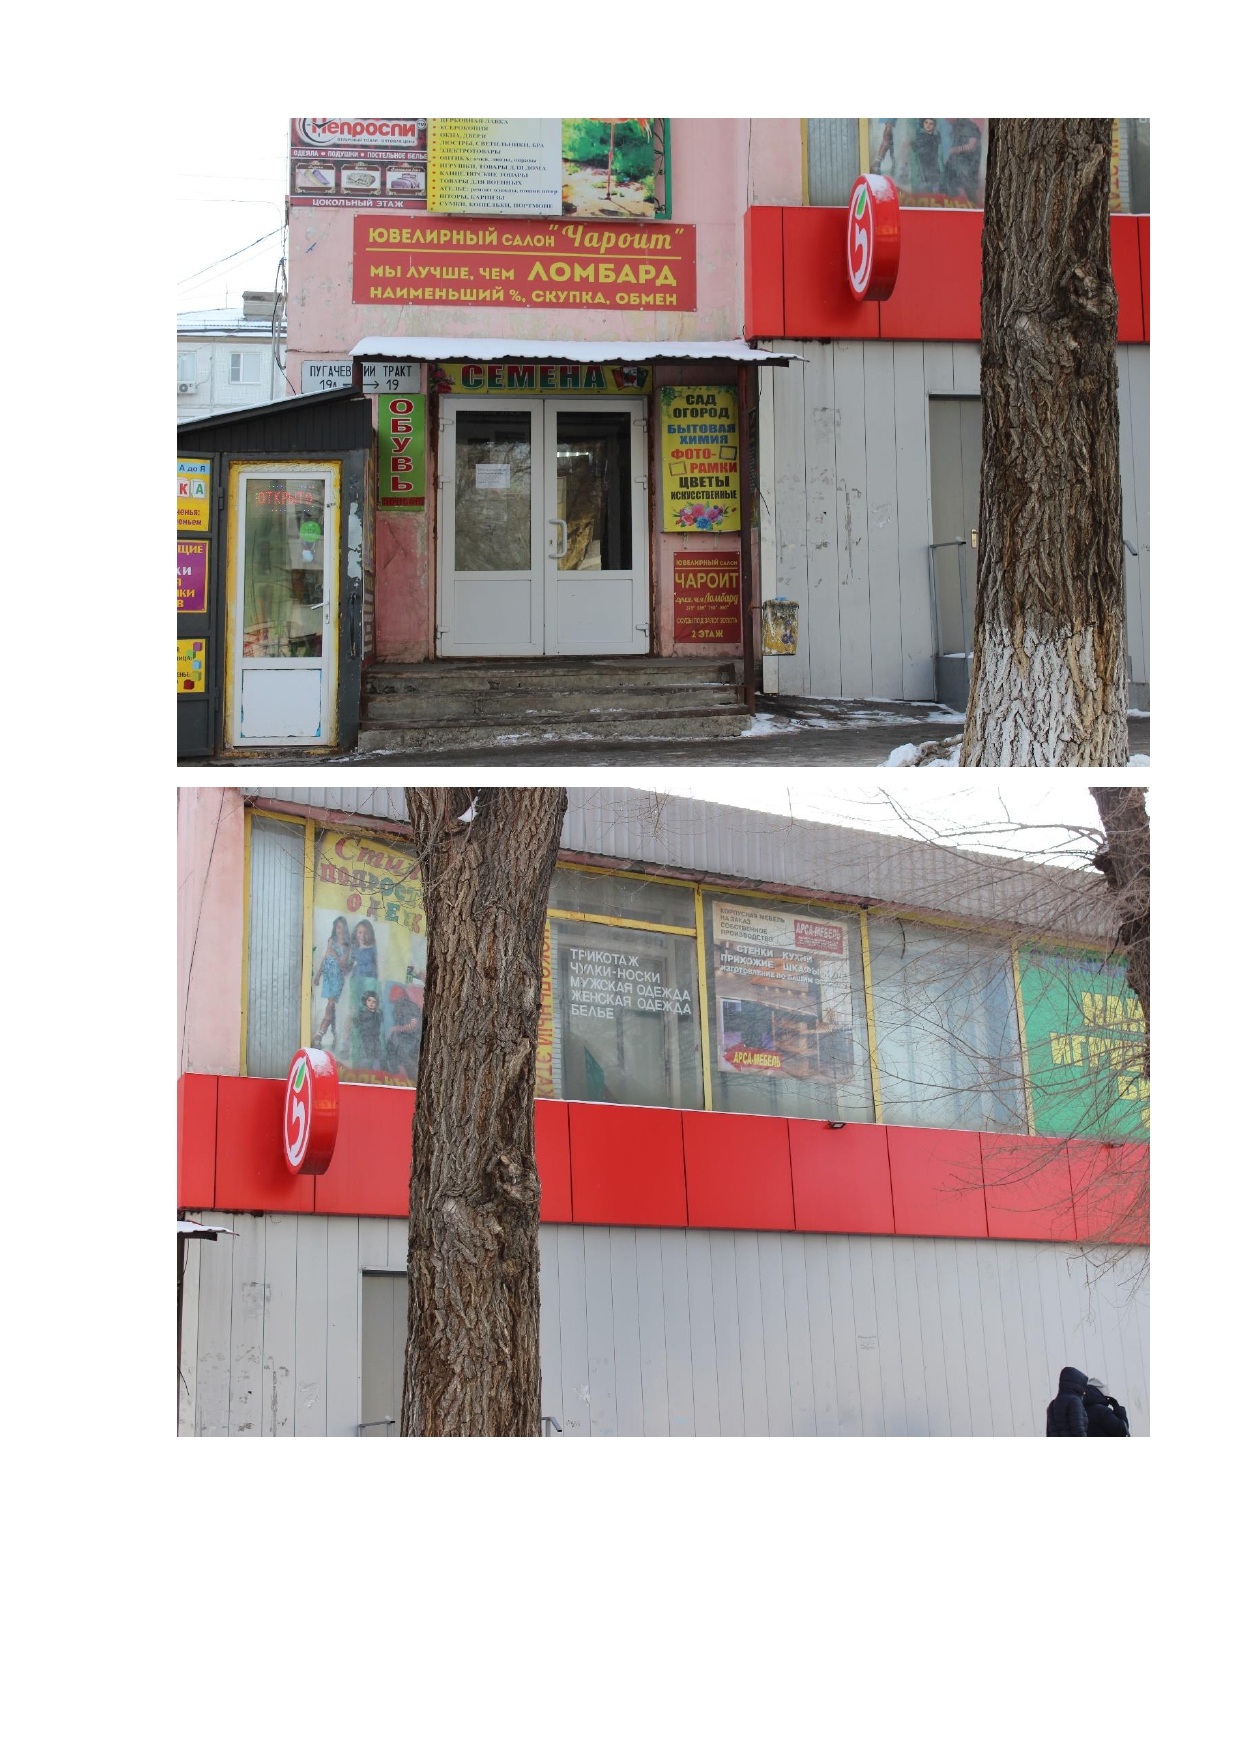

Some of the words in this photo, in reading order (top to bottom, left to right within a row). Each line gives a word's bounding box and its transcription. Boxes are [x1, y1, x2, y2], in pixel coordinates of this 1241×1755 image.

[327, 150, 359, 158] ПОДУШКИ
[312, 197, 373, 207] ЦОКОЛЬНЫЙ
[376, 200, 404, 208] ЭТАЖ
[369, 226, 498, 246] ЮВЕЛИРНЫЙ
[502, 234, 555, 247] САЛОН
[370, 265, 401, 278] МЫ
[407, 266, 474, 281] ЛУЧШЕ,
[479, 267, 515, 281] ЧЕМ
[527, 261, 677, 287] ЛОМБАРД
[370, 286, 504, 301] НАИМЕНЬШИЙ
[509, 290, 526, 303] %,
[531, 290, 610, 305] СКУПКА,
[616, 292, 677, 306] ОБМЕН
[310, 365, 376, 377] ПУГАЧЕВИЙ
[383, 365, 412, 377] ТРАКТ
[460, 364, 607, 389] СЕМЕНА
[386, 379, 399, 391] 19
[685, 394, 717, 407] САД
[672, 407, 730, 420] ОГОРОД
[667, 424, 736, 434] БЫТОВАЯ
[389, 398, 414, 493] ОБУВЬ
[680, 435, 729, 445] ХИМИЯ
[671, 448, 717, 460] ФОТО-
[690, 462, 738, 474] РАМКИ
[679, 476, 730, 489] ЦВЕТЫ
[257, 491, 315, 505] ОТКРЫТО
[671, 490, 738, 500] ИСКУССТВЕННЫЕ
[675, 573, 739, 588] ЧАРОИТ
[692, 630, 697, 638] 2
[698, 630, 723, 638] ЭТАЖ
[721, 908, 758, 918] КОРПУСНАЯ
[759, 914, 786, 923] МЕБЕЛЬ
[730, 916, 751, 925] ЗАКАЗ
[720, 921, 768, 935] СОБСТВЕННОЕ
[720, 929, 774, 942] ПРОИЗВОДСТВО
[570, 948, 639, 967] ТРИКОТАЖ
[720, 954, 775, 968] ПРИХОЖИЕ
[737, 945, 774, 957] СТЕНКИ
[782, 952, 813, 963] КУХНИ
[569, 962, 660, 983] ЧУЛКИ-НОСКИ
[570, 976, 633, 993] МУЖСКАЯ
[636, 985, 691, 1001] ОДЕЖДА
[571, 990, 632, 1007] ЖЕНСКАЯ
[637, 997, 692, 1015] ОДЕЖДА
[571, 1004, 614, 1019] БЕЛЬЕ
[733, 1051, 781, 1068] АРСА-МЕБЕЛЬ
